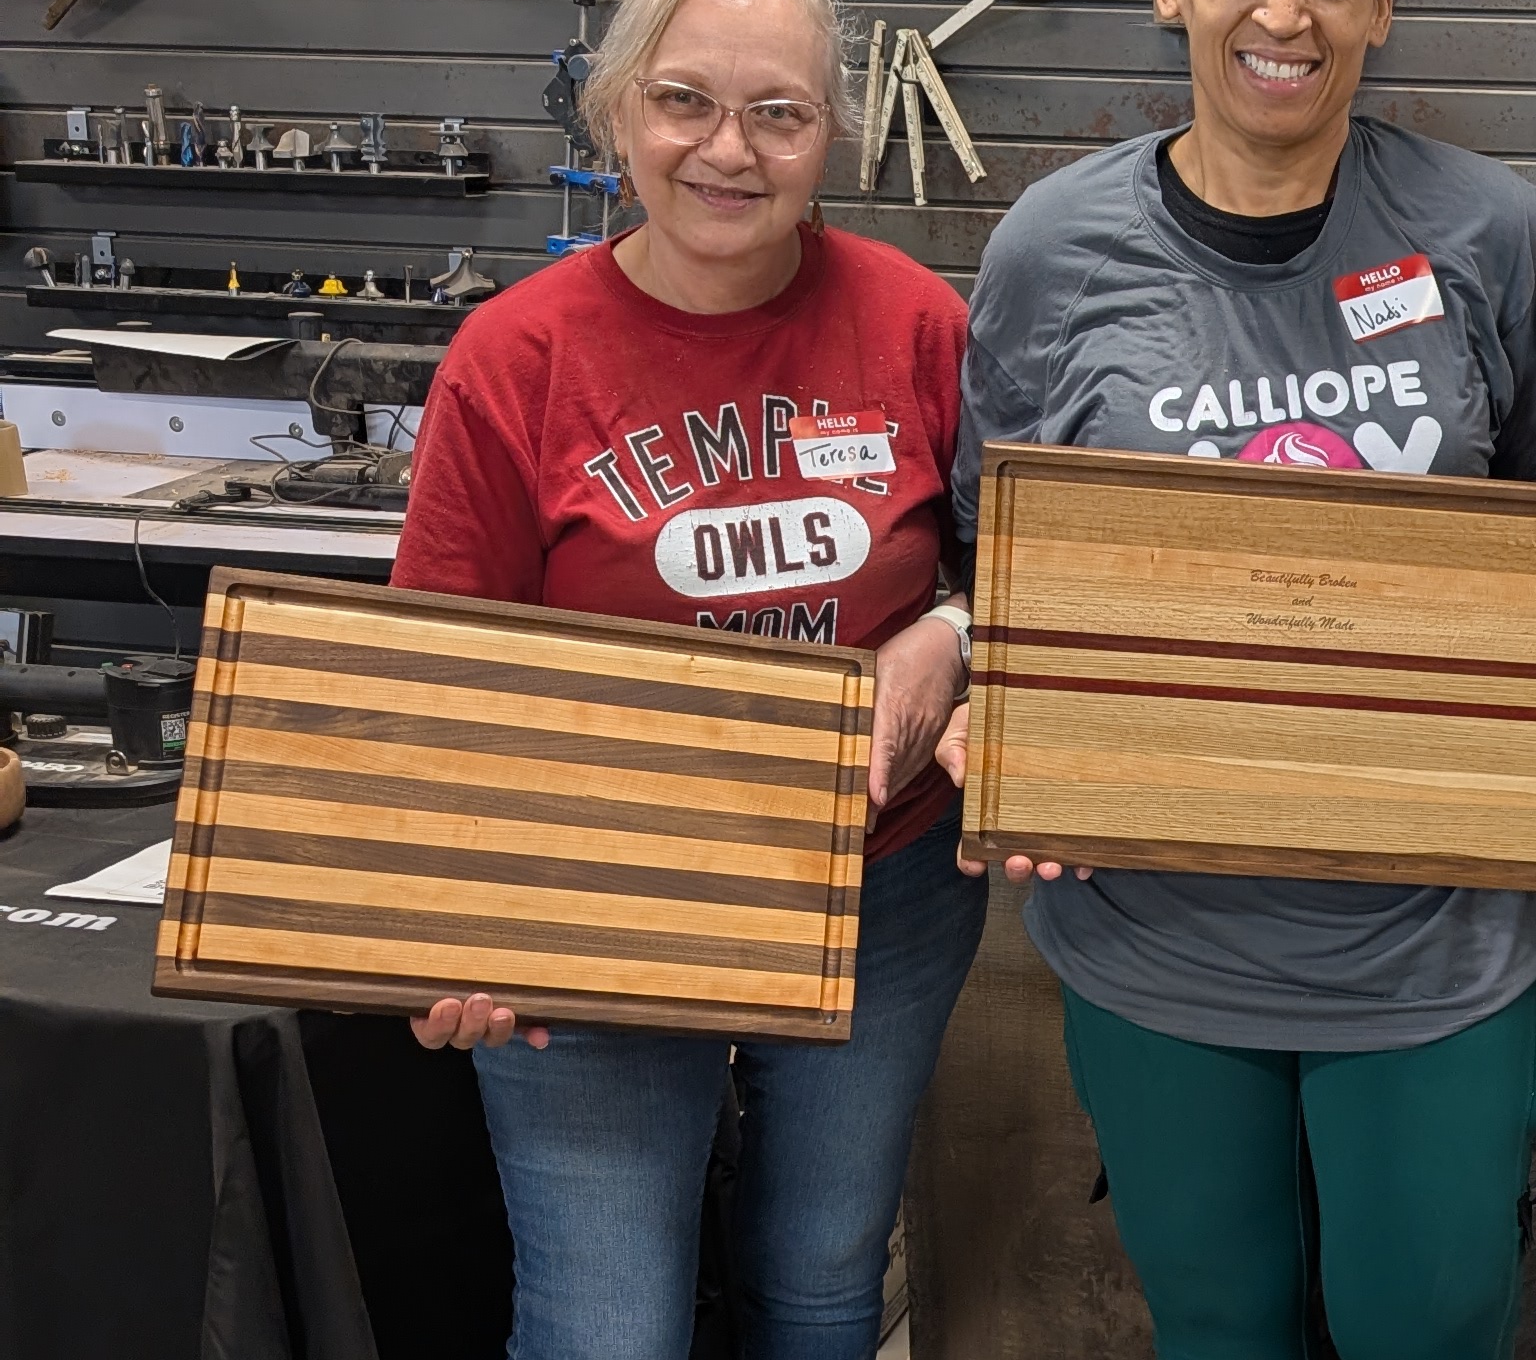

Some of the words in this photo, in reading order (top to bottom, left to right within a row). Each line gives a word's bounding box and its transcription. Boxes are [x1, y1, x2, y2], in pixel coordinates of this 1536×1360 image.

[1359, 266, 1401, 287] HELLO
[1149, 359, 1428, 432] CALLIOPE
[817, 416, 857, 429] HELLO
[584, 394, 899, 521] TEMP
[799, 443, 877, 467] Teresa
[693, 511, 838, 581] OWLS
[1251, 569, 1315, 588] Beautifully
[1319, 573, 1358, 588] Broken
[1292, 596, 1314, 607] and
[1247, 613, 1315, 630] Wonderfully
[1318, 616, 1355, 631] Made
